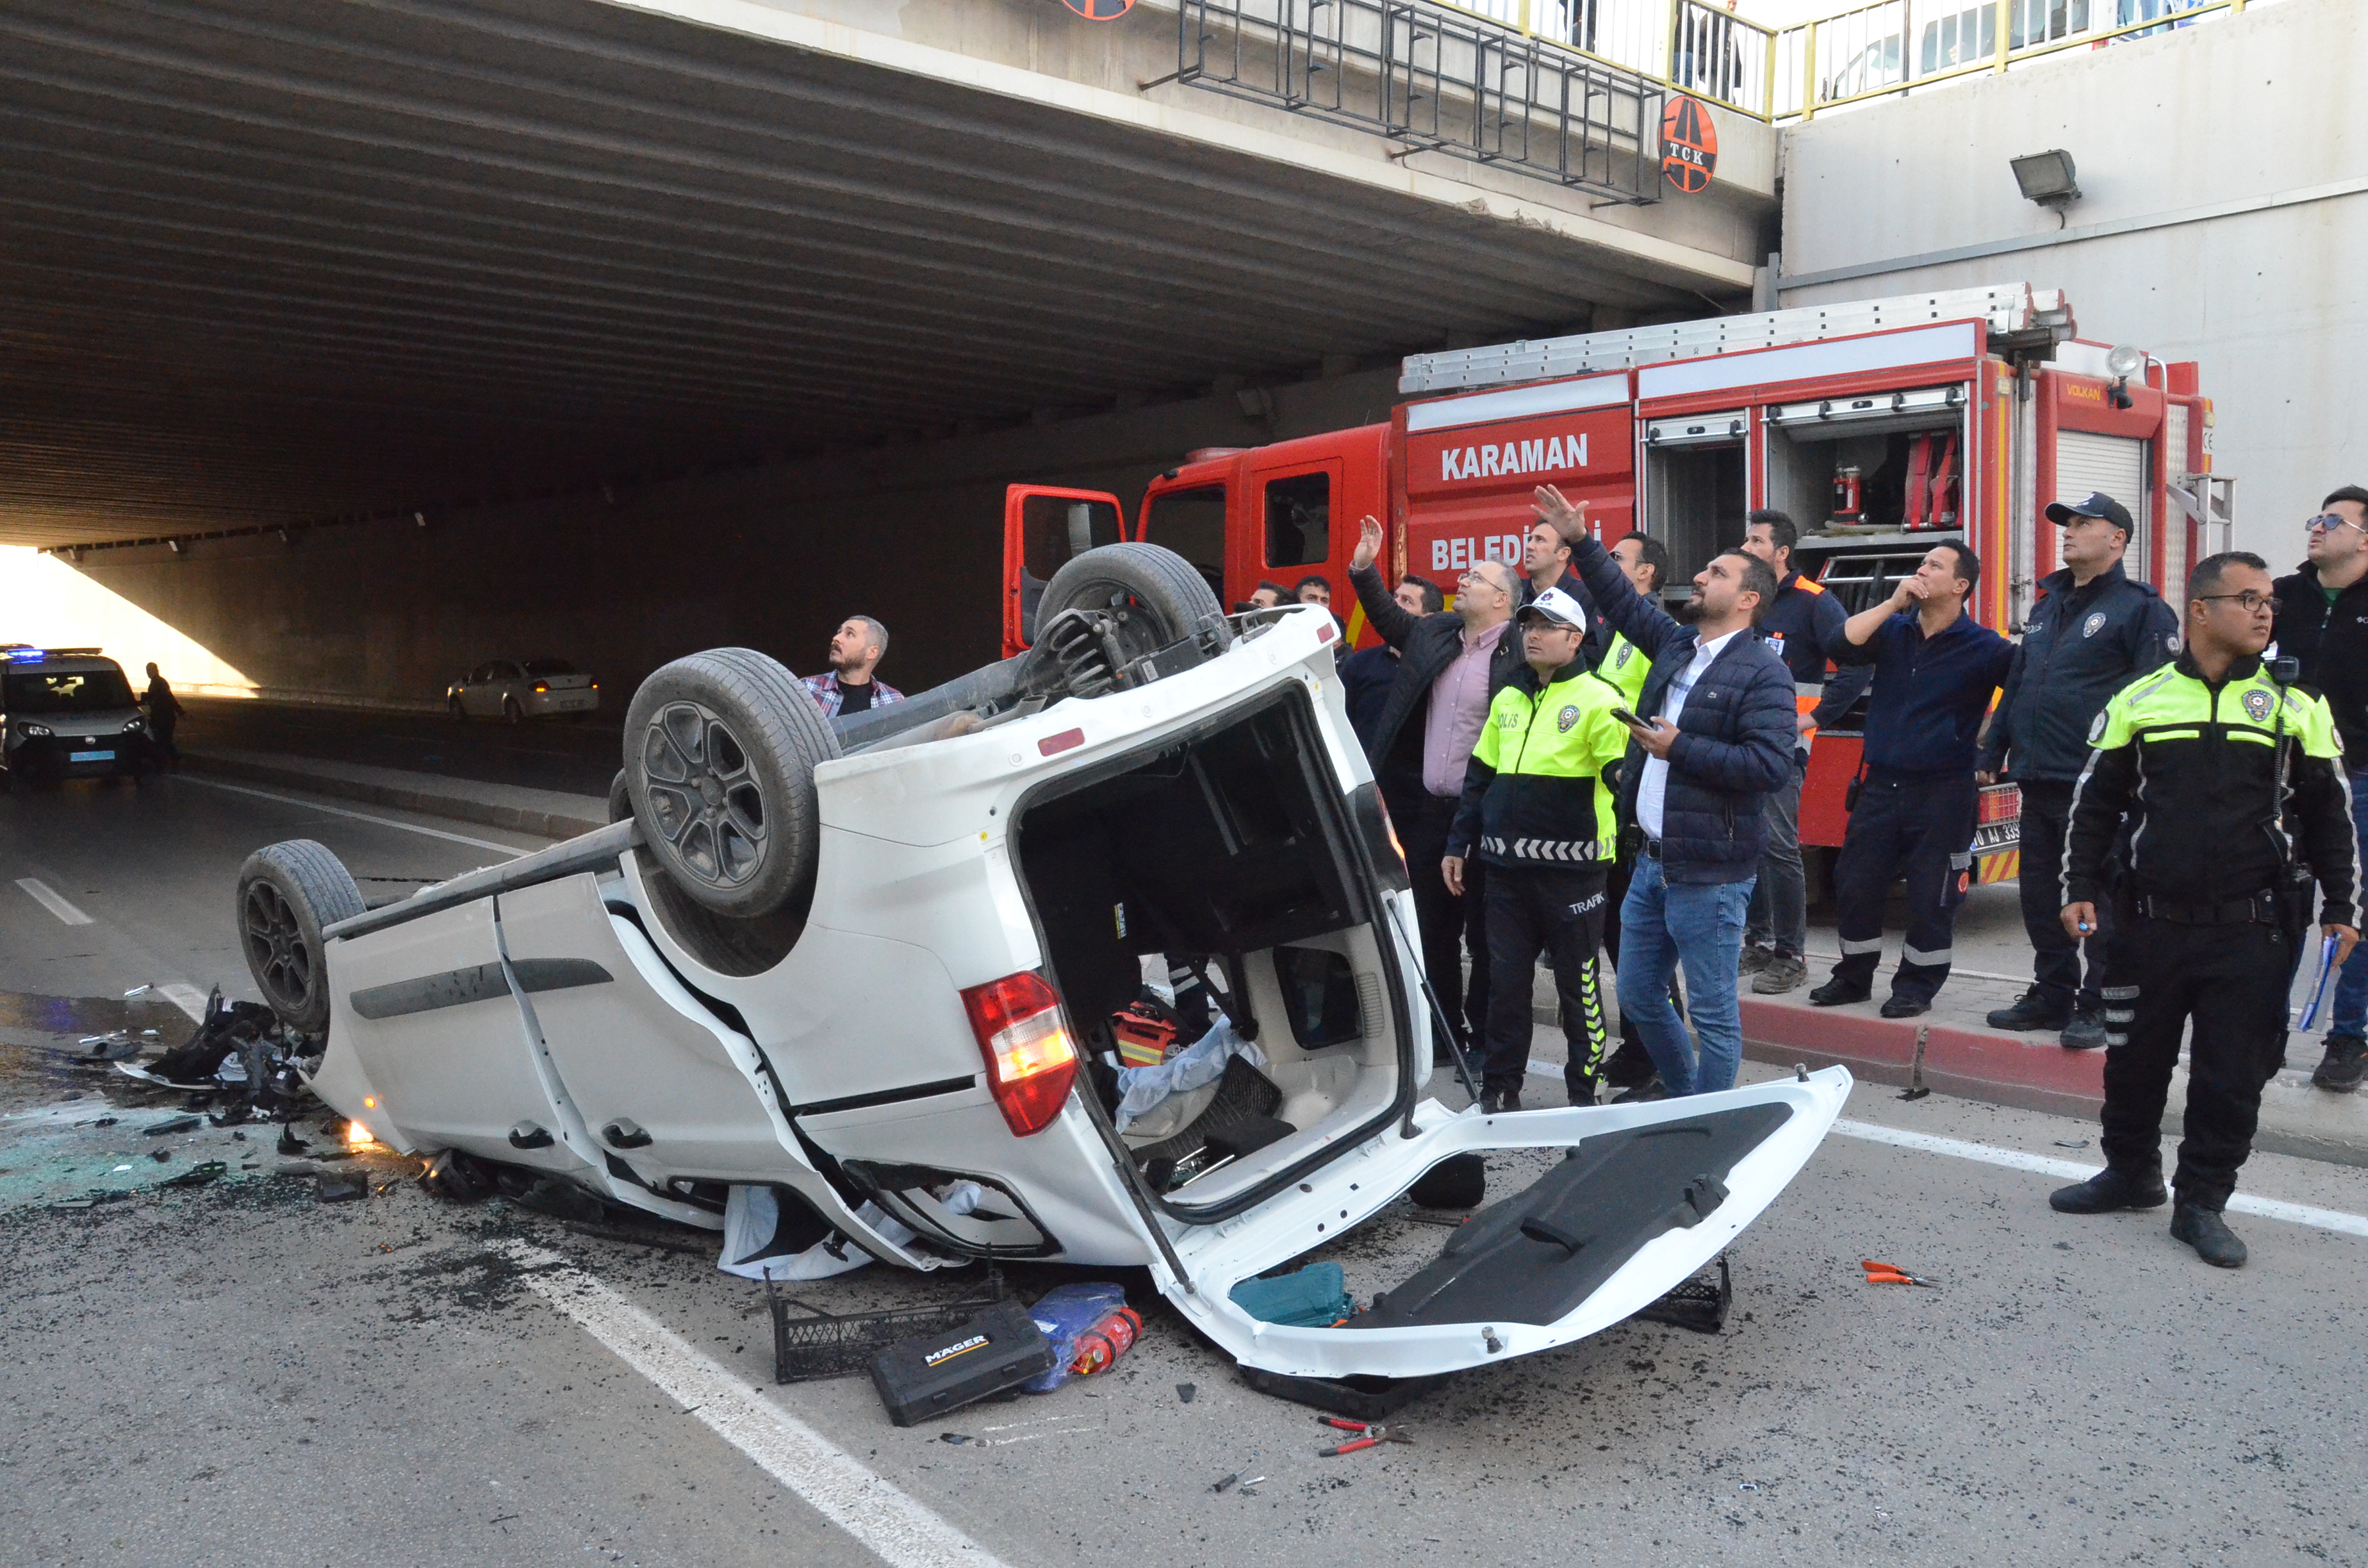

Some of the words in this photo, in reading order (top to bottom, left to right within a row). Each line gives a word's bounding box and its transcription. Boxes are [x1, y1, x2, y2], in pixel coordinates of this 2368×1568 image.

[1670, 143, 1703, 165] TCK
[2067, 384, 2100, 400] VOLKAN
[1442, 434, 1588, 480] KARAMAN
[2003, 821, 2020, 840] 339
[925, 1335, 987, 1363] MÄGER
